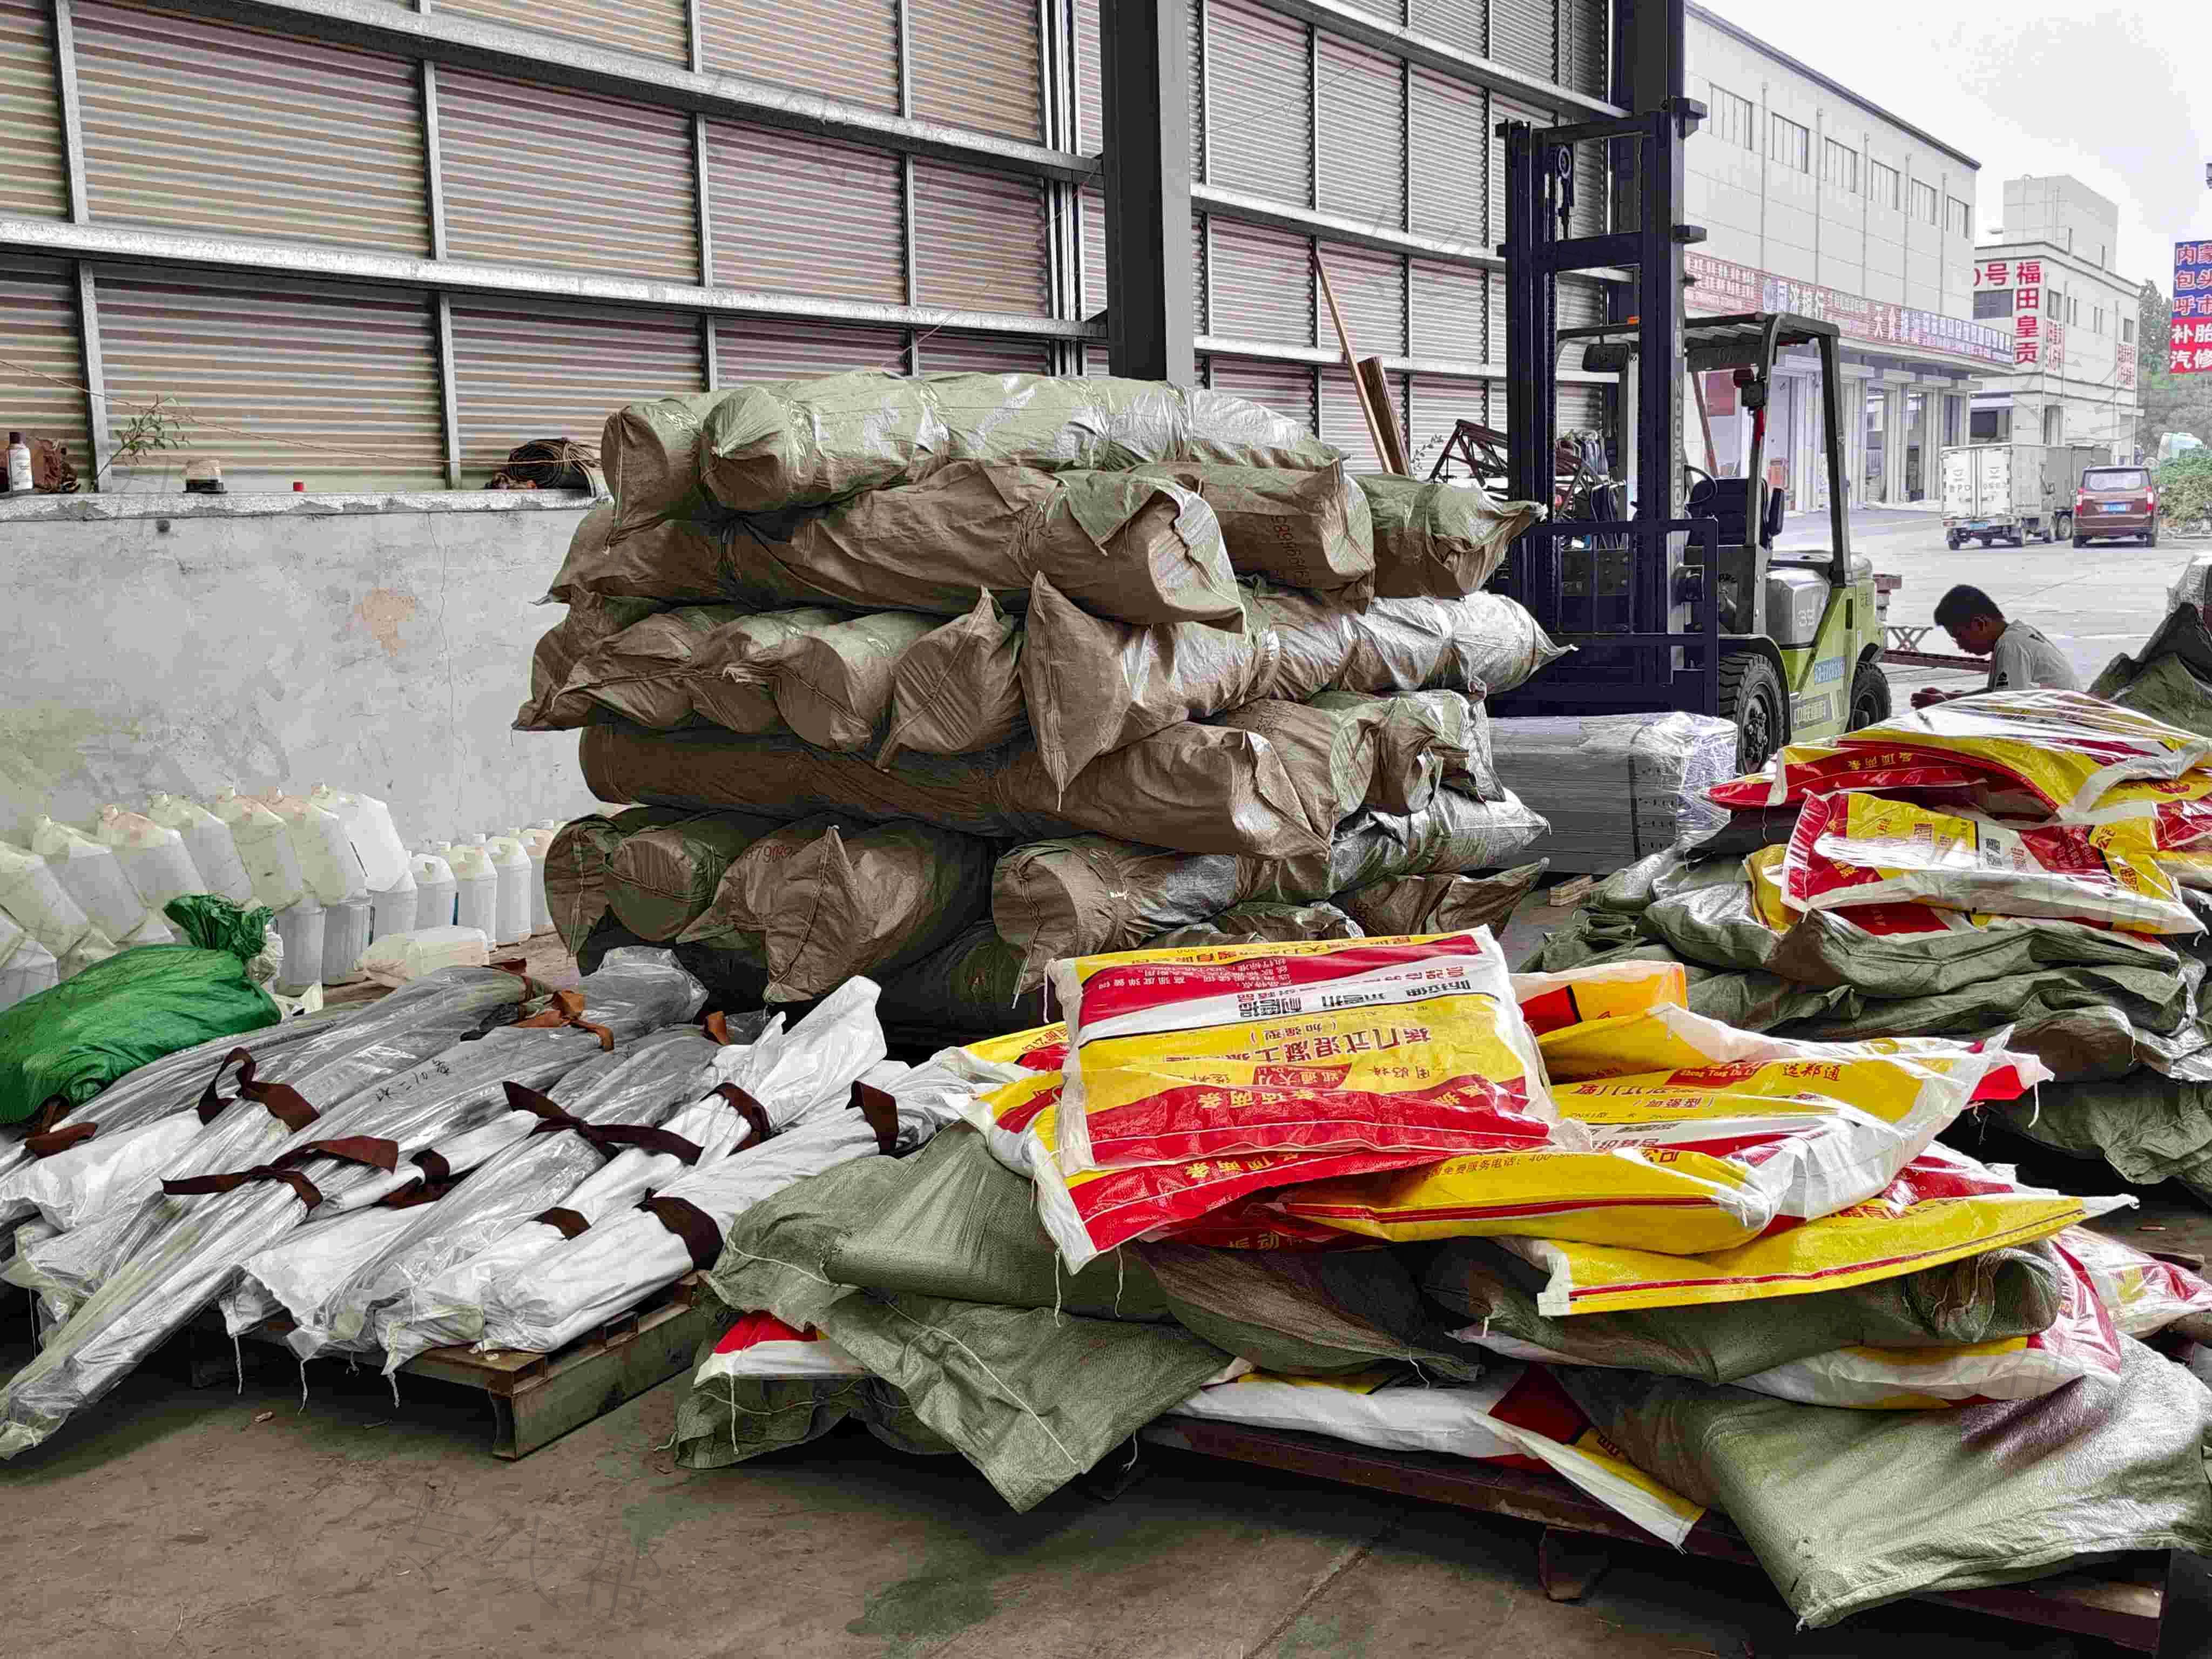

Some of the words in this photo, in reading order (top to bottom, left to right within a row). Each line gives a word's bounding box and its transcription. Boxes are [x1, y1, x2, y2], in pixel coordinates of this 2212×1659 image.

[2015, 261, 2042, 365] 福田皇贡
[2171, 323, 2212, 345] 补胎
[2170, 349, 2212, 369] 汽修
[1783, 1063, 1840, 1081] 选郑通
